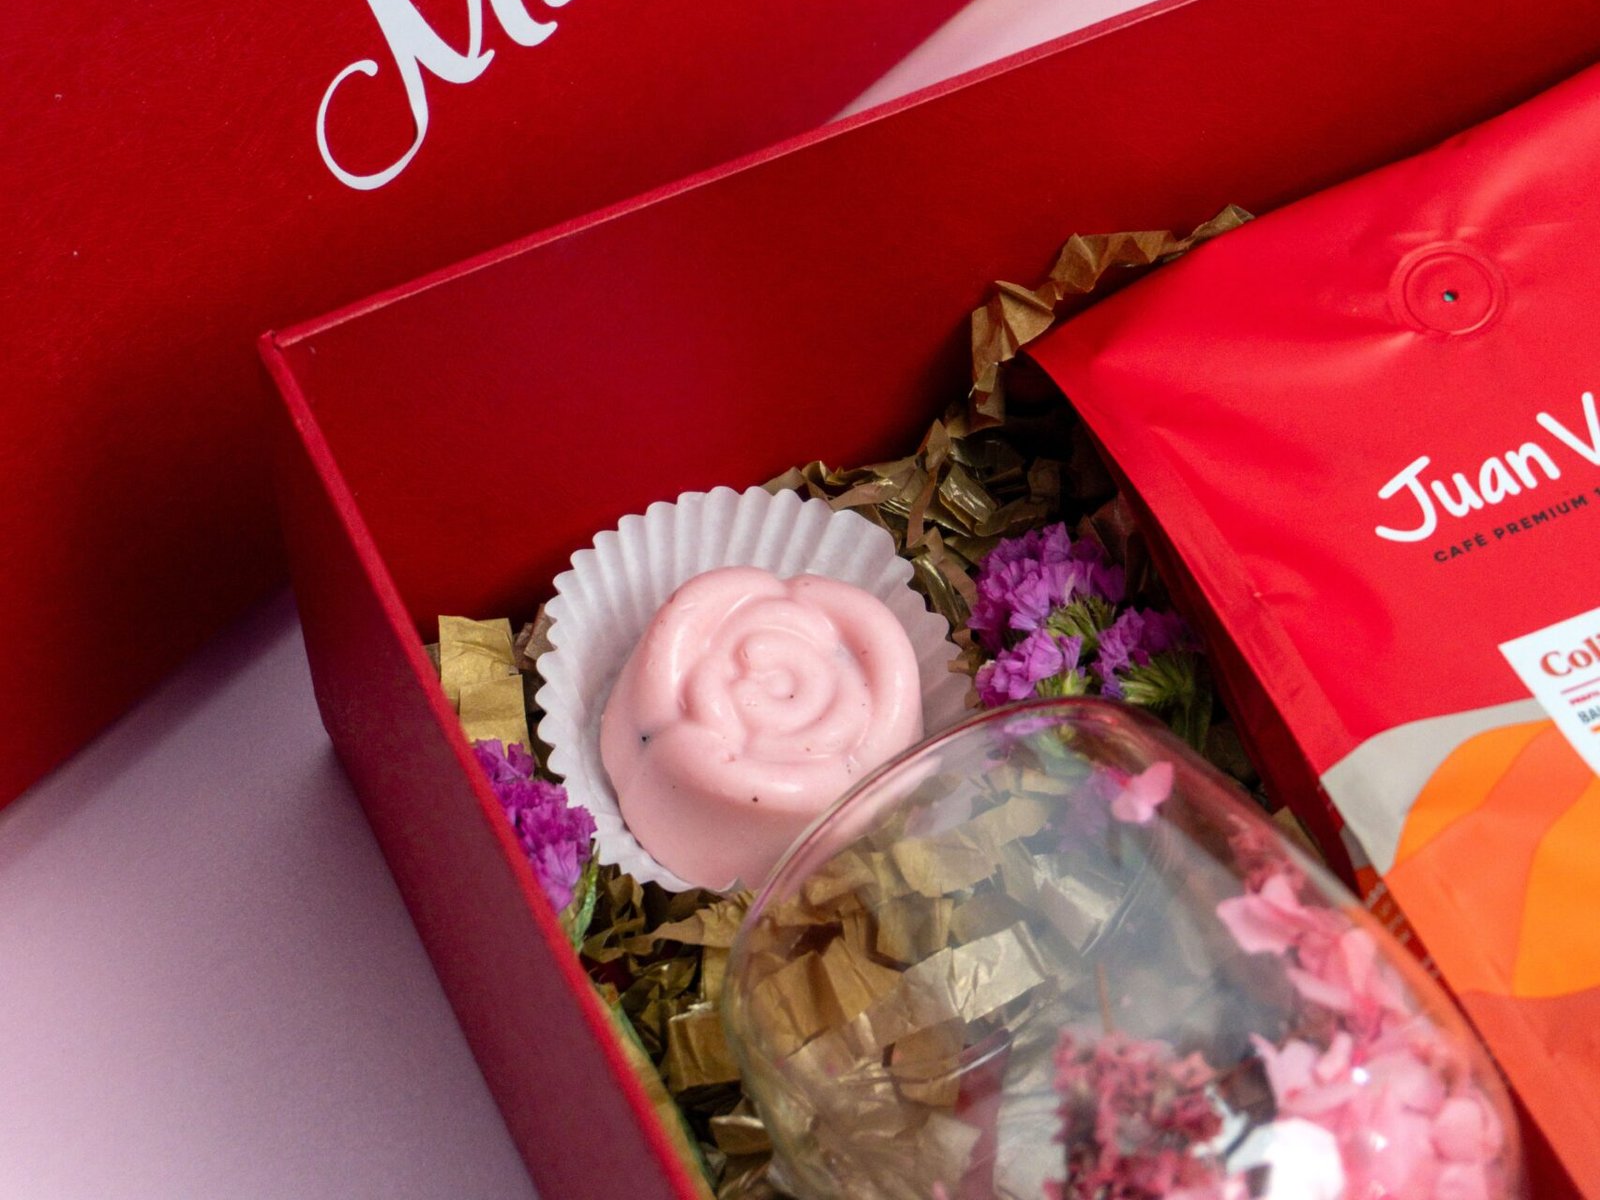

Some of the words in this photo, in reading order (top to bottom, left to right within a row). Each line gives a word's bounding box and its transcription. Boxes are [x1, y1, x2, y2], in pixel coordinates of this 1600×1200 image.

[1374, 441, 1561, 543] Juan
[1433, 533, 1488, 563] CAFÉ
[1494, 495, 1588, 540] PREMIUM
[1540, 633, 1600, 677] Col
